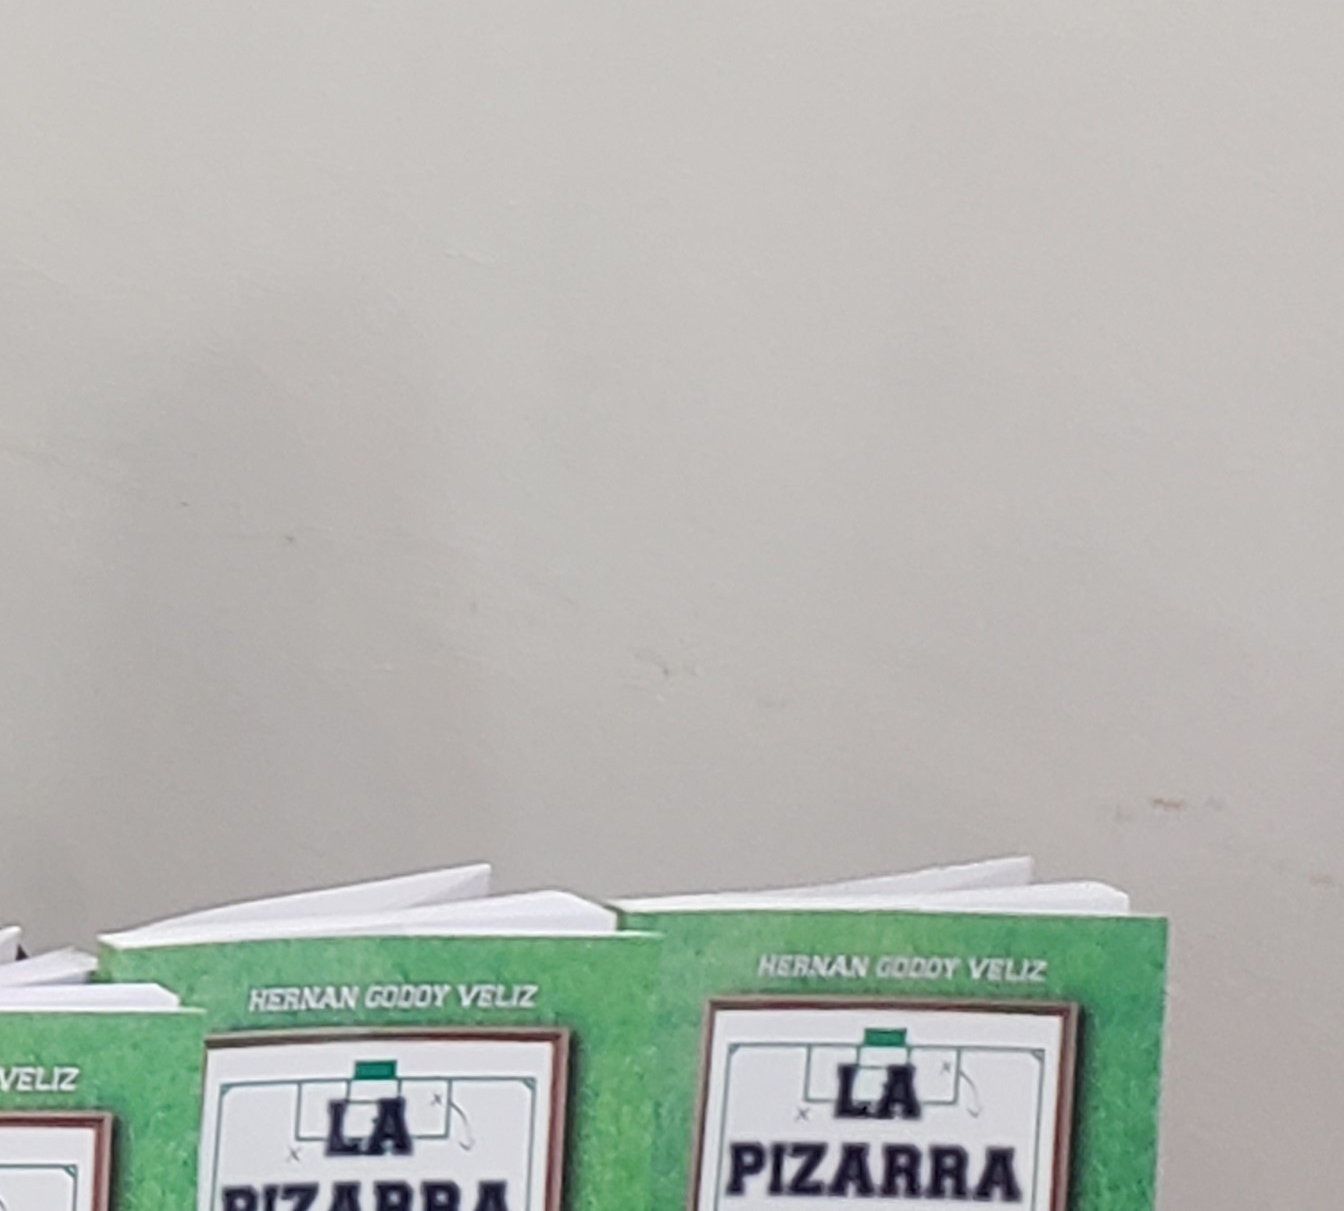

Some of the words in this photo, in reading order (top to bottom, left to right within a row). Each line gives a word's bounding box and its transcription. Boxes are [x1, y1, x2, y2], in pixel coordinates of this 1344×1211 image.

[757, 953, 871, 979] HERNAN
[876, 956, 962, 980] GODOY
[967, 957, 1049, 982] VELIZ
[248, 986, 360, 1012] HERNAN
[363, 985, 452, 1010] GODOY
[457, 983, 539, 1009] VELIZ
[832, 1063, 923, 1120] LA
[324, 1097, 415, 1157] LA
[724, 1140, 1023, 1205] PIZARRA
